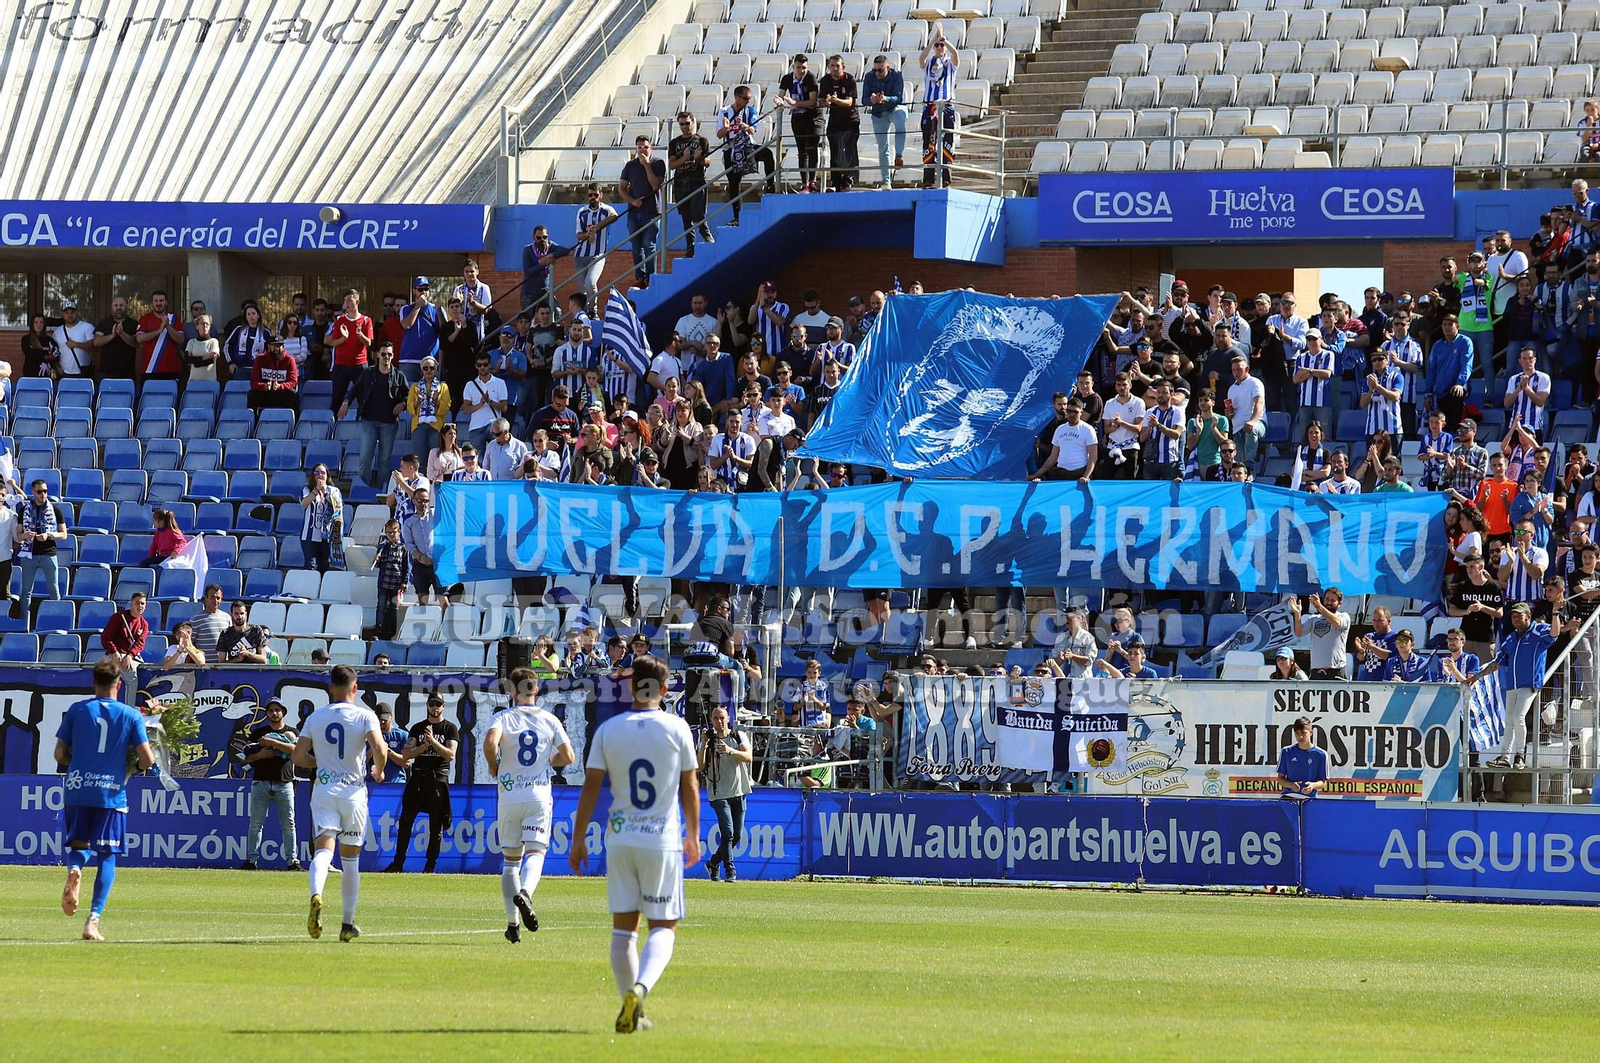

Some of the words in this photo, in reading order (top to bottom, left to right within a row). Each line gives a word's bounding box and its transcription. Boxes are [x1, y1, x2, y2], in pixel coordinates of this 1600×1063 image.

[1073, 189, 1173, 223] CEOSA
[1208, 185, 1296, 217] Huelva
[1320, 186, 1425, 220] CEOSA
[122, 217, 232, 249] energía
[243, 217, 287, 248] del
[1229, 217, 1253, 229] me
[1261, 216, 1296, 232] pone
[262, 371, 286, 380] adidas
[454, 492, 755, 577] HUELVA
[818, 500, 1005, 576] D.E.P.
[1057, 504, 1432, 587] HERMANO
[1462, 593, 1501, 603] ENDLING
[194, 695, 229, 707] ONUBA
[1273, 688, 1371, 714] SECTOR
[96, 717, 109, 753] 1
[1005, 710, 1053, 731] Banda
[1061, 713, 1119, 732] Suicida
[325, 722, 345, 760] 9
[517, 729, 538, 767] 8
[906, 754, 953, 776] Forza
[955, 757, 1001, 776] Recre
[628, 758, 656, 810] 6
[1143, 780, 1162, 791] Gol
[1164, 775, 1180, 787] Sur
[1364, 780, 1418, 795] ESPAÑOL
[819, 812, 1283, 869] WWW.autopartshuelva.es
